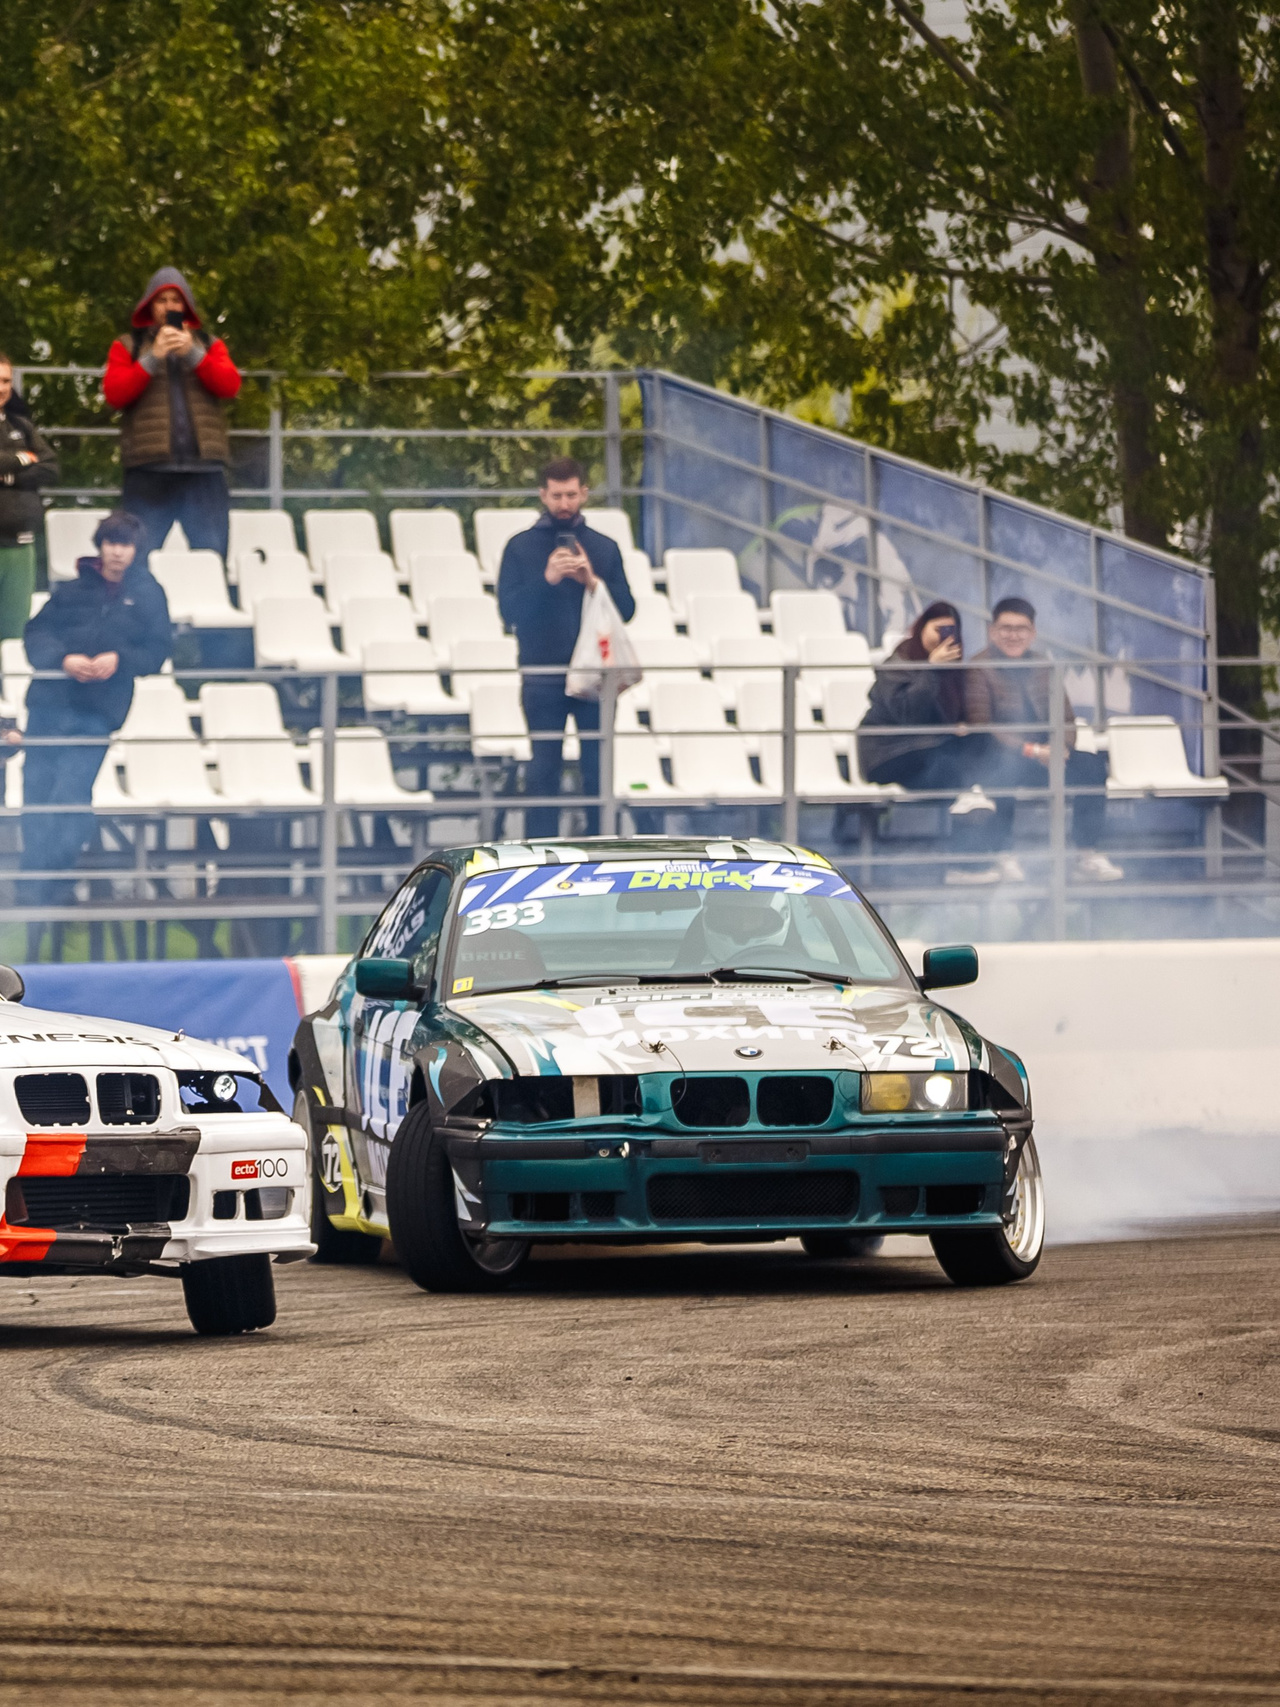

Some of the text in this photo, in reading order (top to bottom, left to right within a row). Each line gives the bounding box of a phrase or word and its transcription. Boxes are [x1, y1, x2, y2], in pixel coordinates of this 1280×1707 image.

[665, 863, 709, 873] GORILLA
[628, 870, 753, 891] DRIFT
[463, 900, 545, 936] 333
[460, 951, 527, 961] BRIDE
[573, 998, 868, 1037] ICE
[871, 1035, 949, 1056] 72
[322, 1143, 343, 1184] 72
